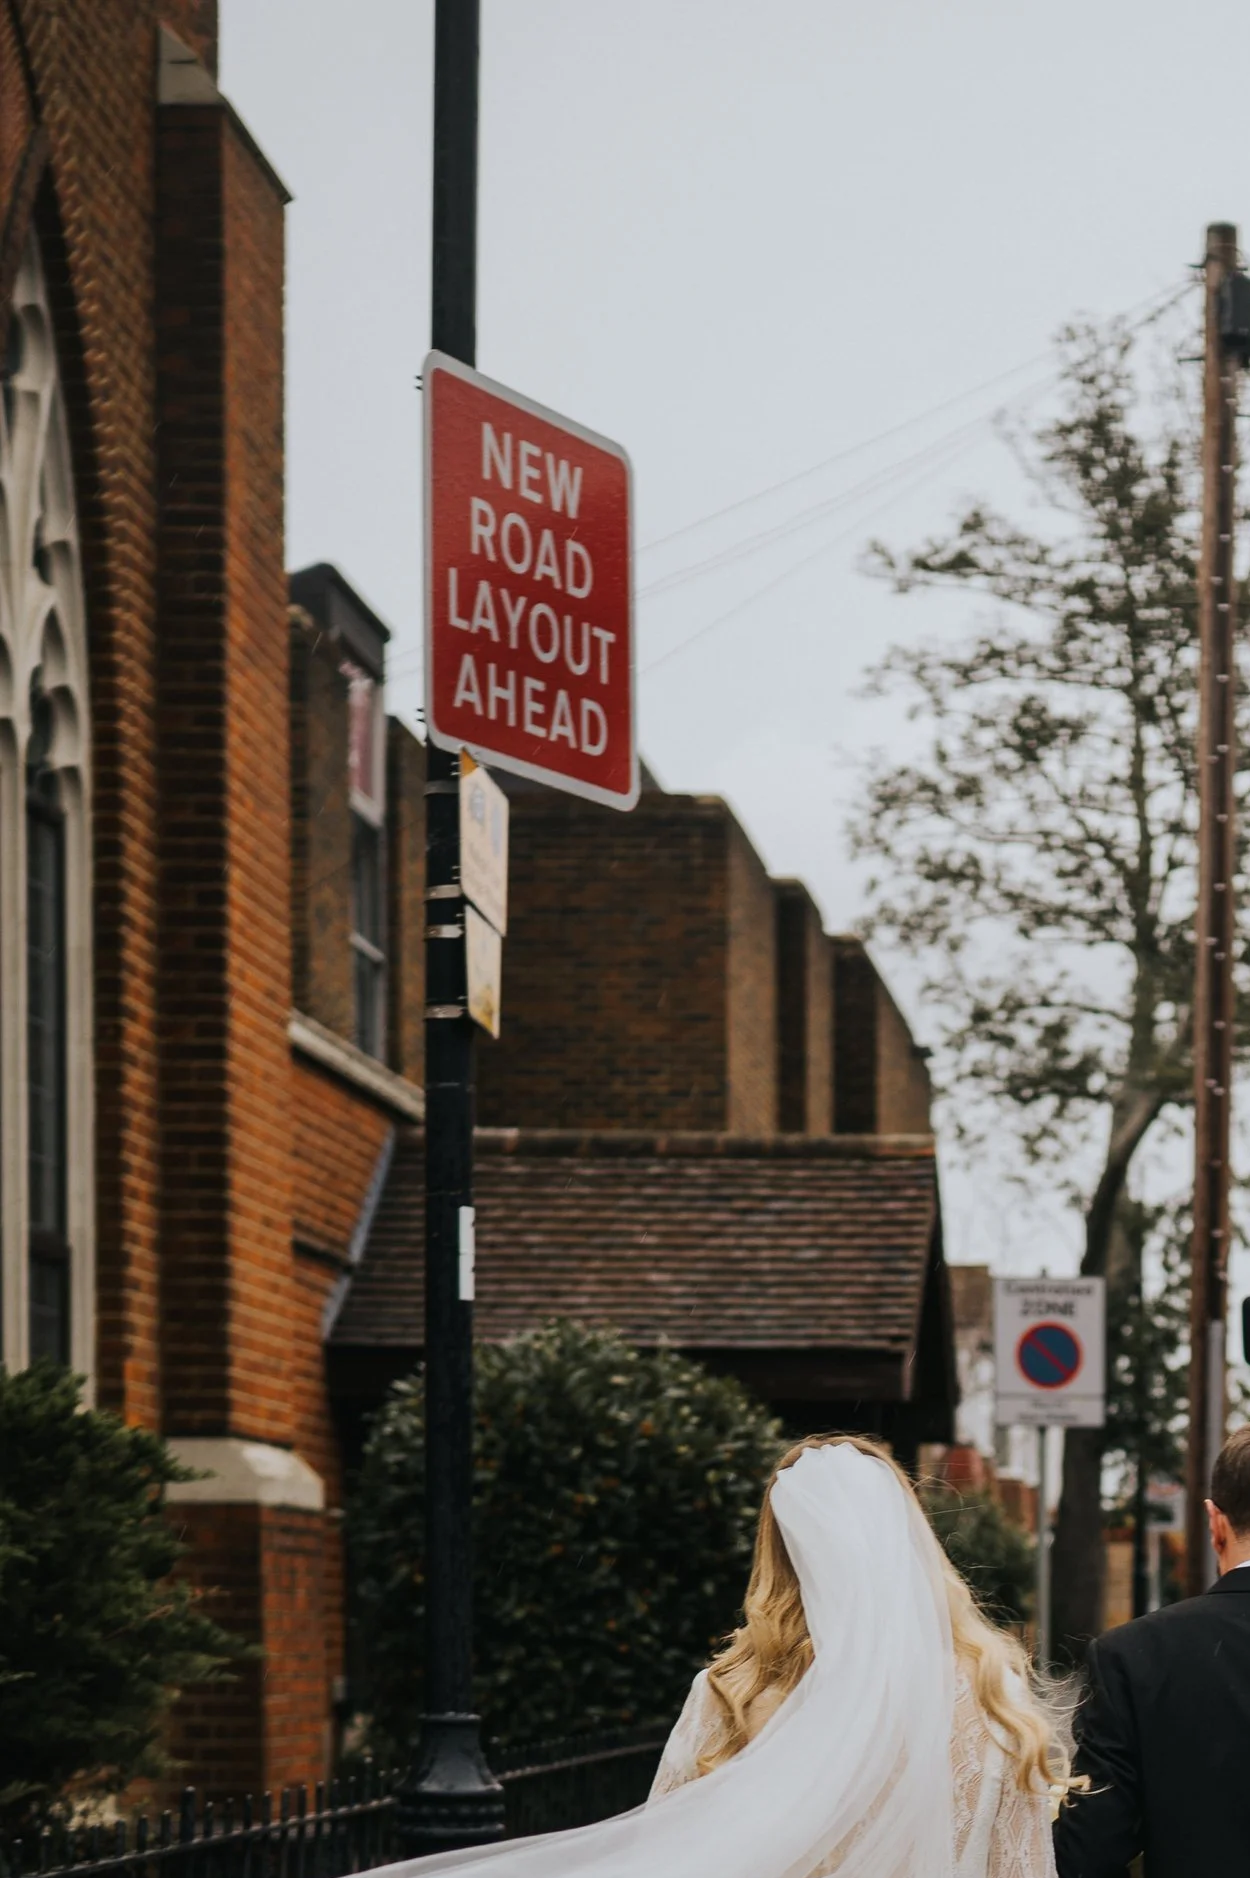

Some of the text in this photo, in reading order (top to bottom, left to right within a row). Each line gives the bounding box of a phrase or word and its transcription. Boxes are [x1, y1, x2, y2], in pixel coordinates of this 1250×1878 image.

[482, 421, 583, 519] NEW
[470, 496, 593, 599] ROAD
[448, 567, 616, 685] LAYOUT
[453, 653, 608, 757] AHEAD
